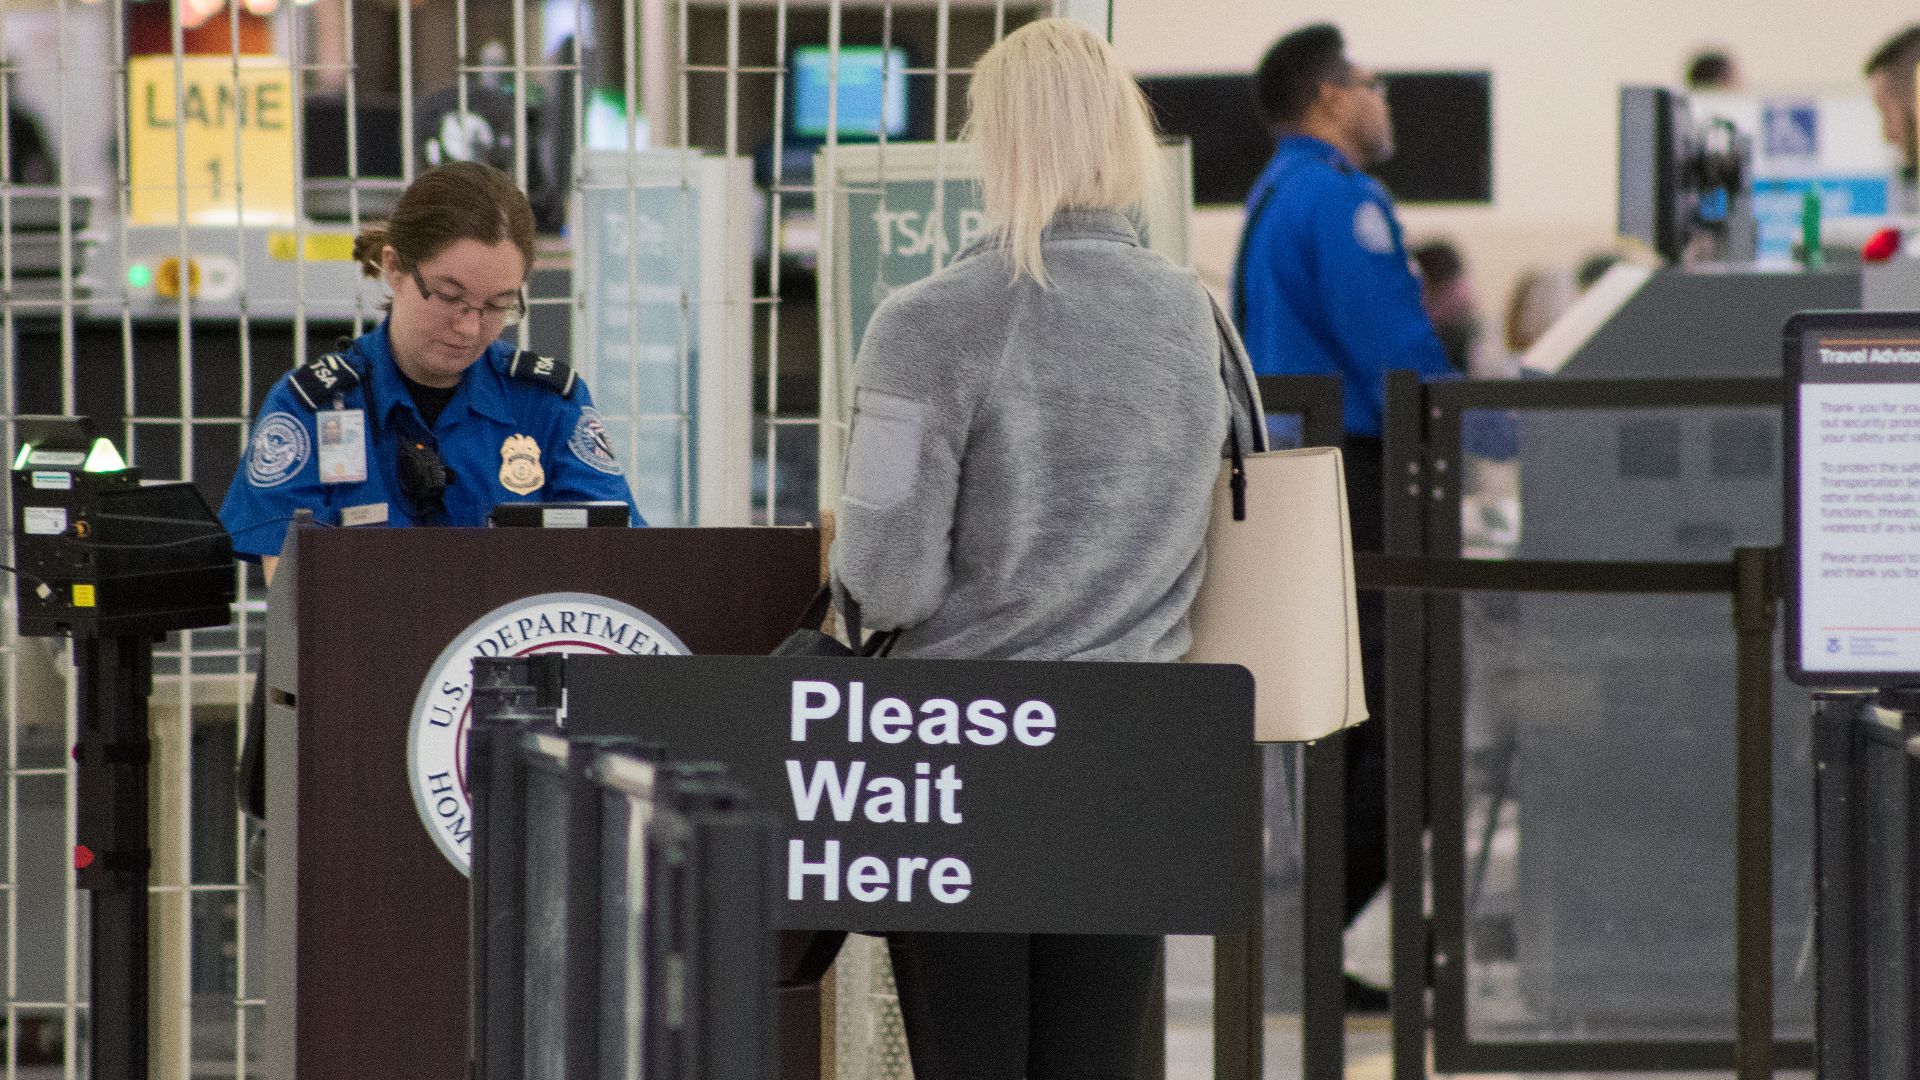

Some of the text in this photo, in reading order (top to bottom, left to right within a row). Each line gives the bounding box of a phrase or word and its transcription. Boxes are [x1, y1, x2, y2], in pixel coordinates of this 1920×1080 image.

[145, 82, 283, 129] LANE
[206, 158, 221, 201] 1
[872, 209, 950, 256] TSA
[310, 359, 338, 389] TSA
[533, 356, 555, 376] TSA
[1819, 347, 1867, 364] Travel
[1820, 401, 1853, 414] Thank
[1820, 477, 1904, 490] Transportation
[1821, 551, 1857, 563] Please
[429, 681, 469, 729] U.S.
[791, 680, 1057, 747] Please
[428, 771, 471, 847] HOM
[785, 760, 963, 824] Wait
[787, 839, 973, 904] Here
